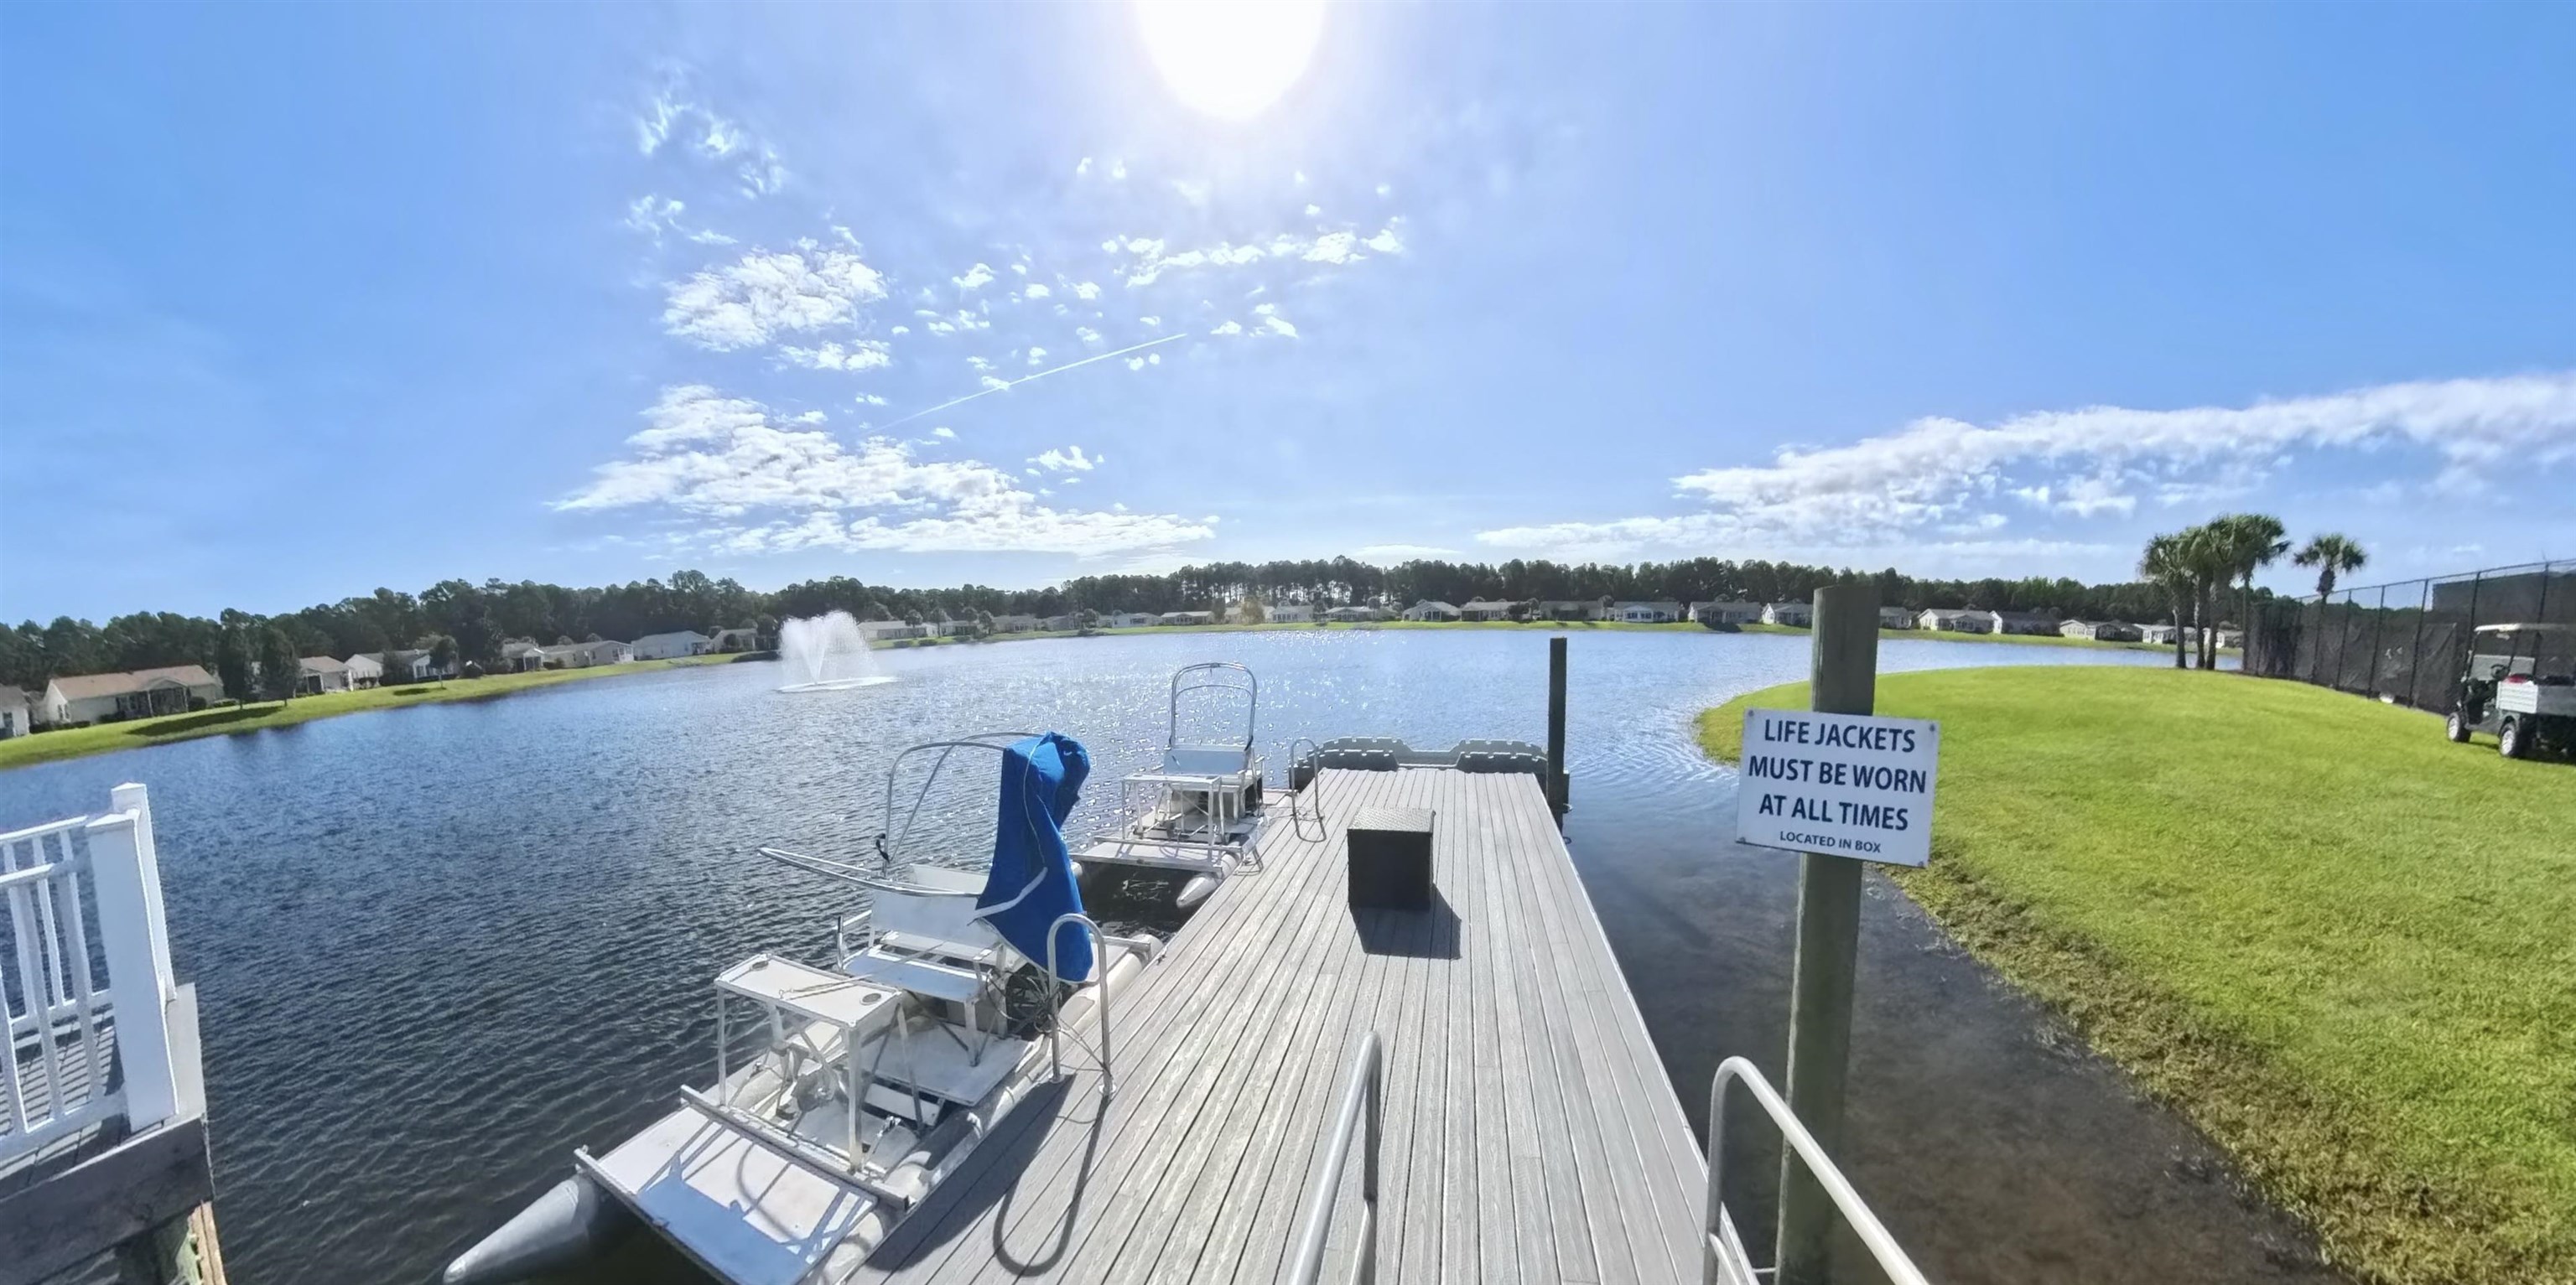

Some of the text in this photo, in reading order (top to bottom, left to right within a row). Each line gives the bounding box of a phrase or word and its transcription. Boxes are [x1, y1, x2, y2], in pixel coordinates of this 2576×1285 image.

[1764, 719, 1915, 753] LIFE JACKETS
[1748, 755, 1926, 794] MUST BE WORN
[1758, 794, 1909, 831] AT ALL TIMES
[1779, 831, 1881, 853] LOCATED IN BOX
